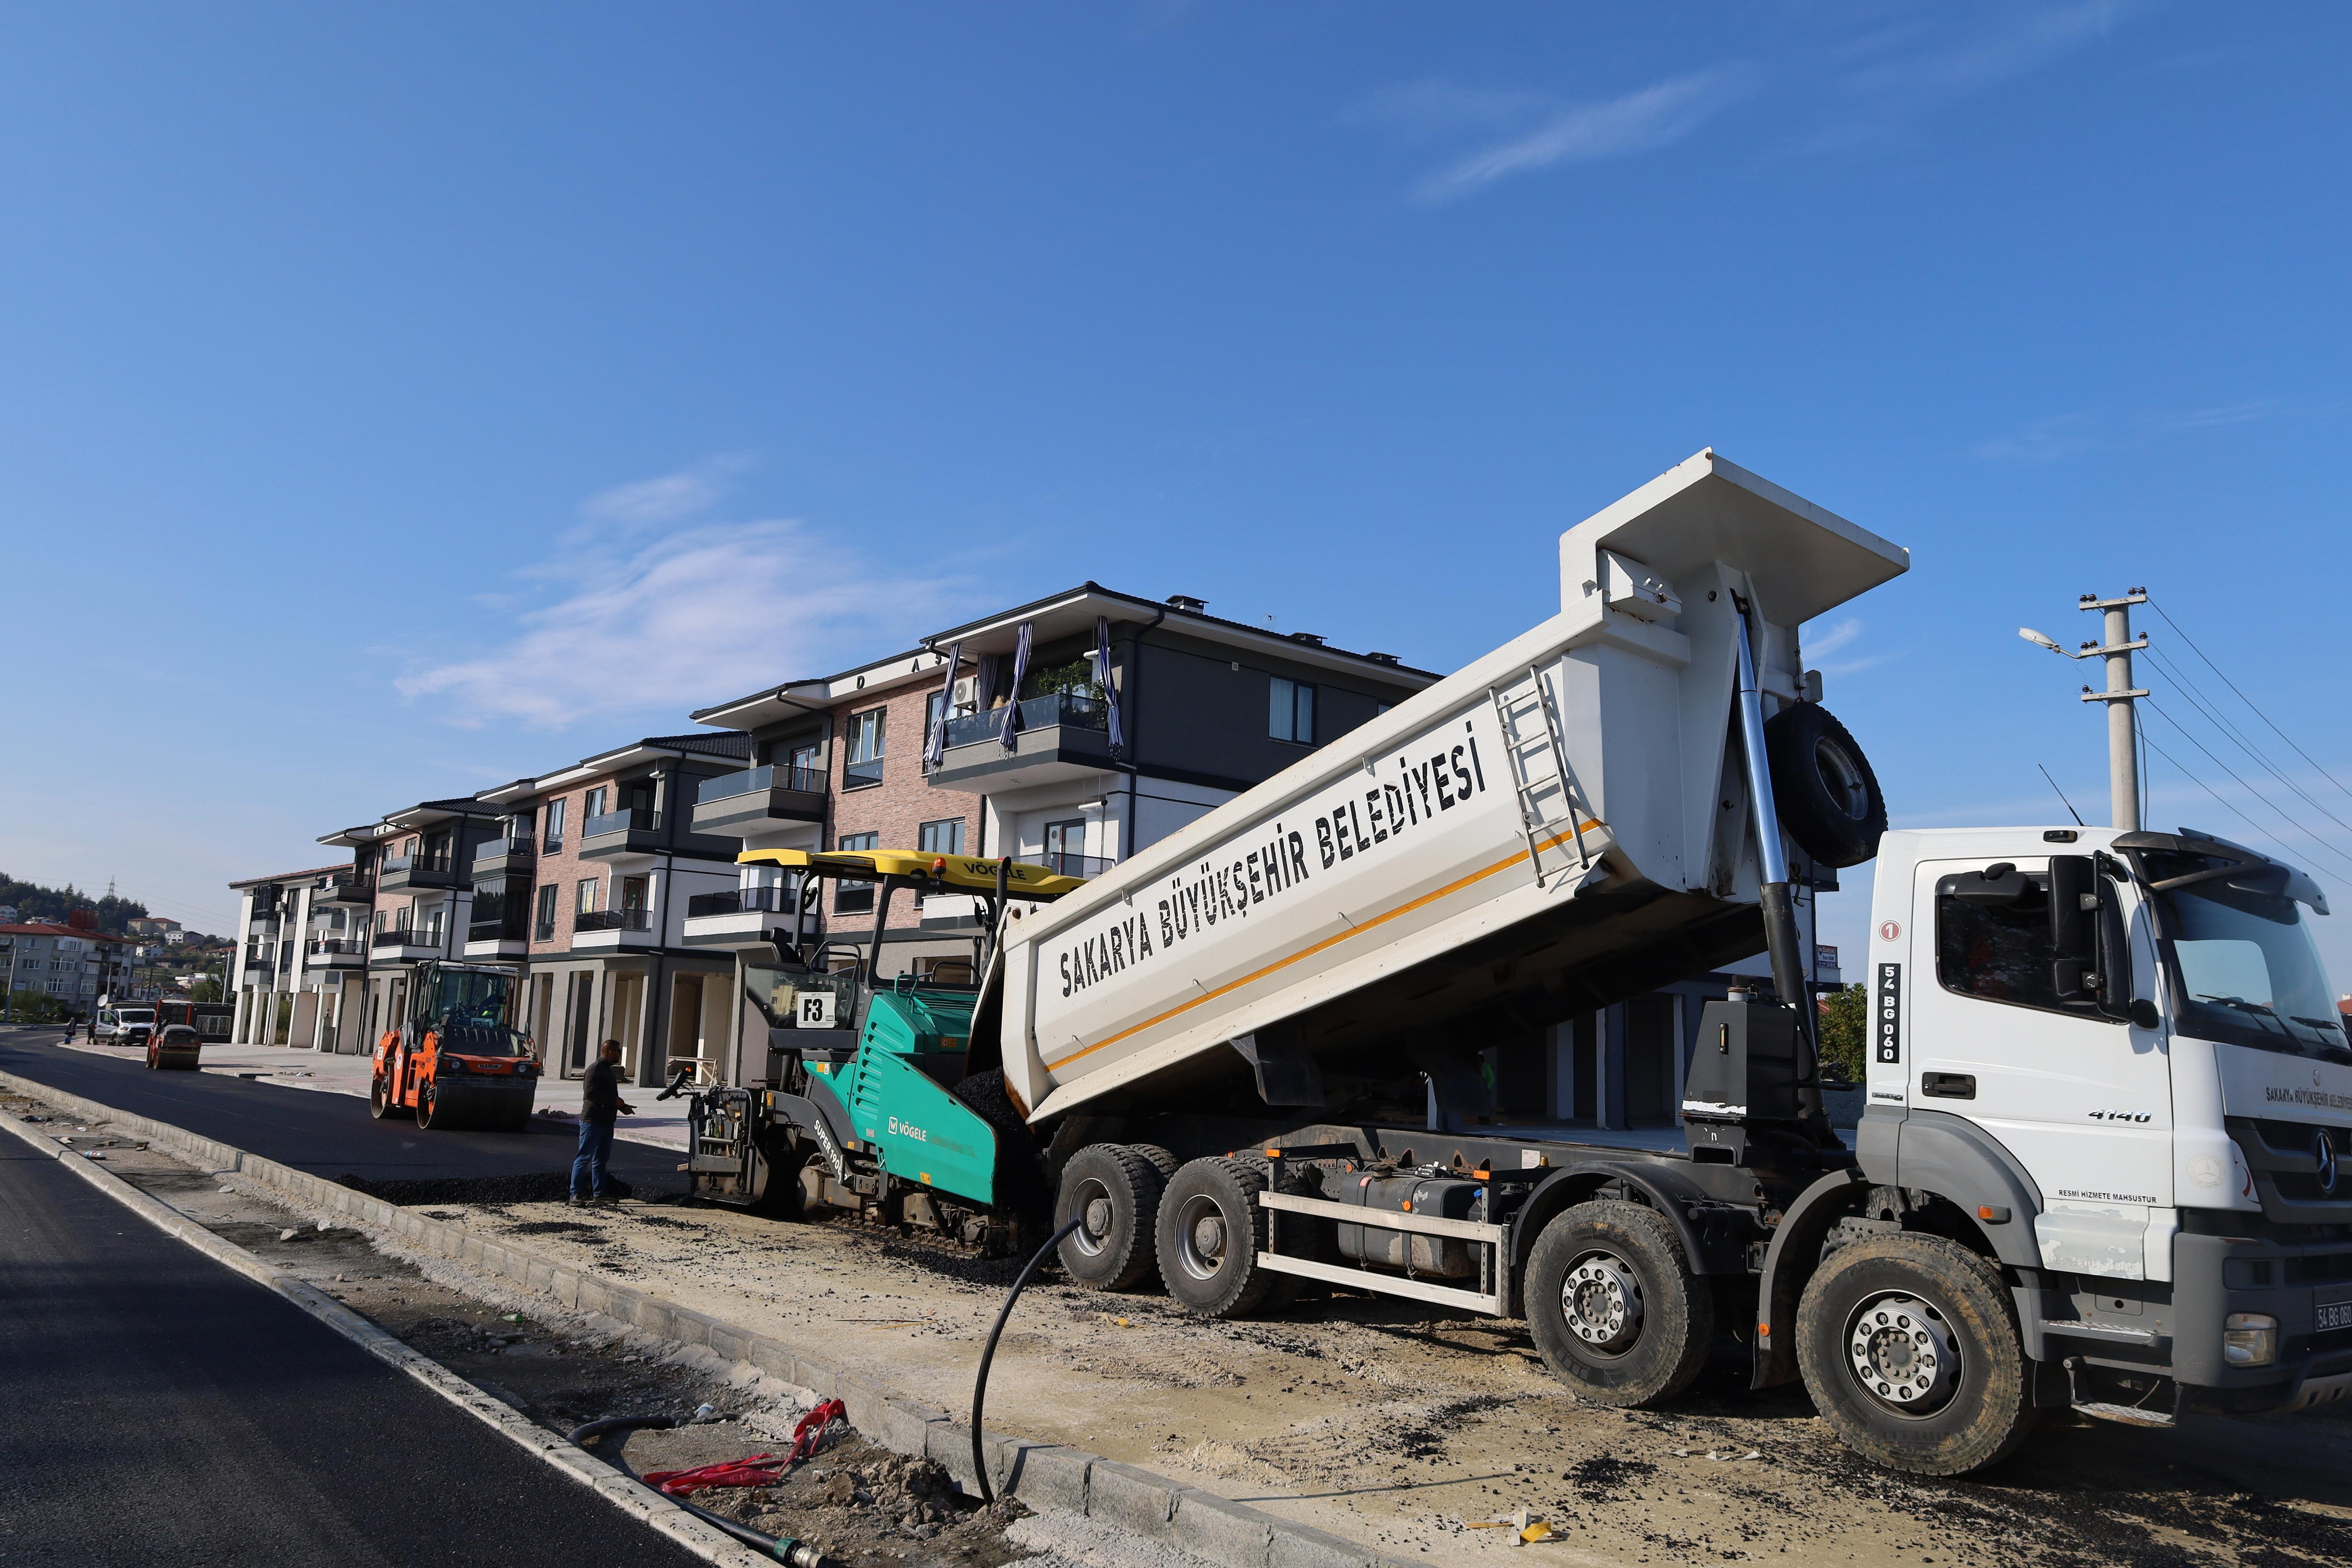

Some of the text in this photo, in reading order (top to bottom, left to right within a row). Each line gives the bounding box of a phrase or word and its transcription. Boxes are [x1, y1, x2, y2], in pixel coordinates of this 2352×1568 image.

[1061, 720, 1486, 997] SAKARYA BÜYÜKŞEHİR BELEDİYESİ
[963, 861, 1026, 880] VÖGLE
[1886, 924, 1894, 938] 1
[803, 998, 823, 1022] F3
[1883, 966, 1895, 1060] 54 BG 060
[2266, 1087, 2294, 1103] SAKARYA
[2088, 1109, 2152, 1123] 4140
[814, 1120, 831, 1154] SUPER
[899, 1121, 927, 1142] VÖGELE
[2081, 1190, 2111, 1200] HİZMETE
[2113, 1194, 2157, 1203] MAHSUSTUR
[2318, 1305, 2352, 1328] 54 BG 060
